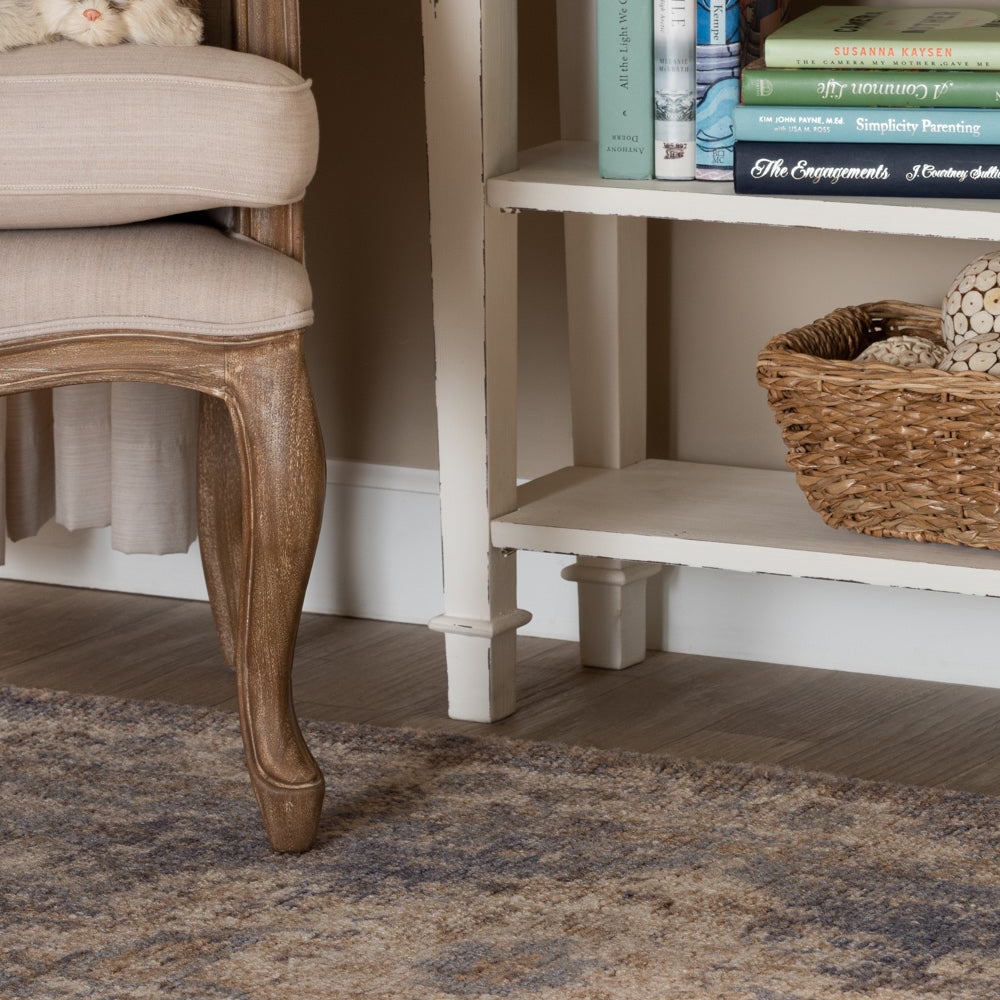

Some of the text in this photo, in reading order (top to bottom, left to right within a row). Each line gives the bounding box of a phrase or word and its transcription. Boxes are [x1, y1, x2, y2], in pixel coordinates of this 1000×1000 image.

[618, 7, 628, 24] We
[711, 4, 723, 41] Kempe
[618, 26, 631, 53] Light
[833, 46, 953, 57] SUSANNA KAYSEN
[619, 56, 629, 72] the
[619, 75, 629, 90] All
[816, 79, 954, 100] A Common Life
[775, 116, 796, 124] JOHN
[856, 117, 981, 137] Simplicity Parenting
[750, 158, 890, 184] The Engagements
[905, 164, 921, 182] J.
[921, 163, 969, 182] Courtney
